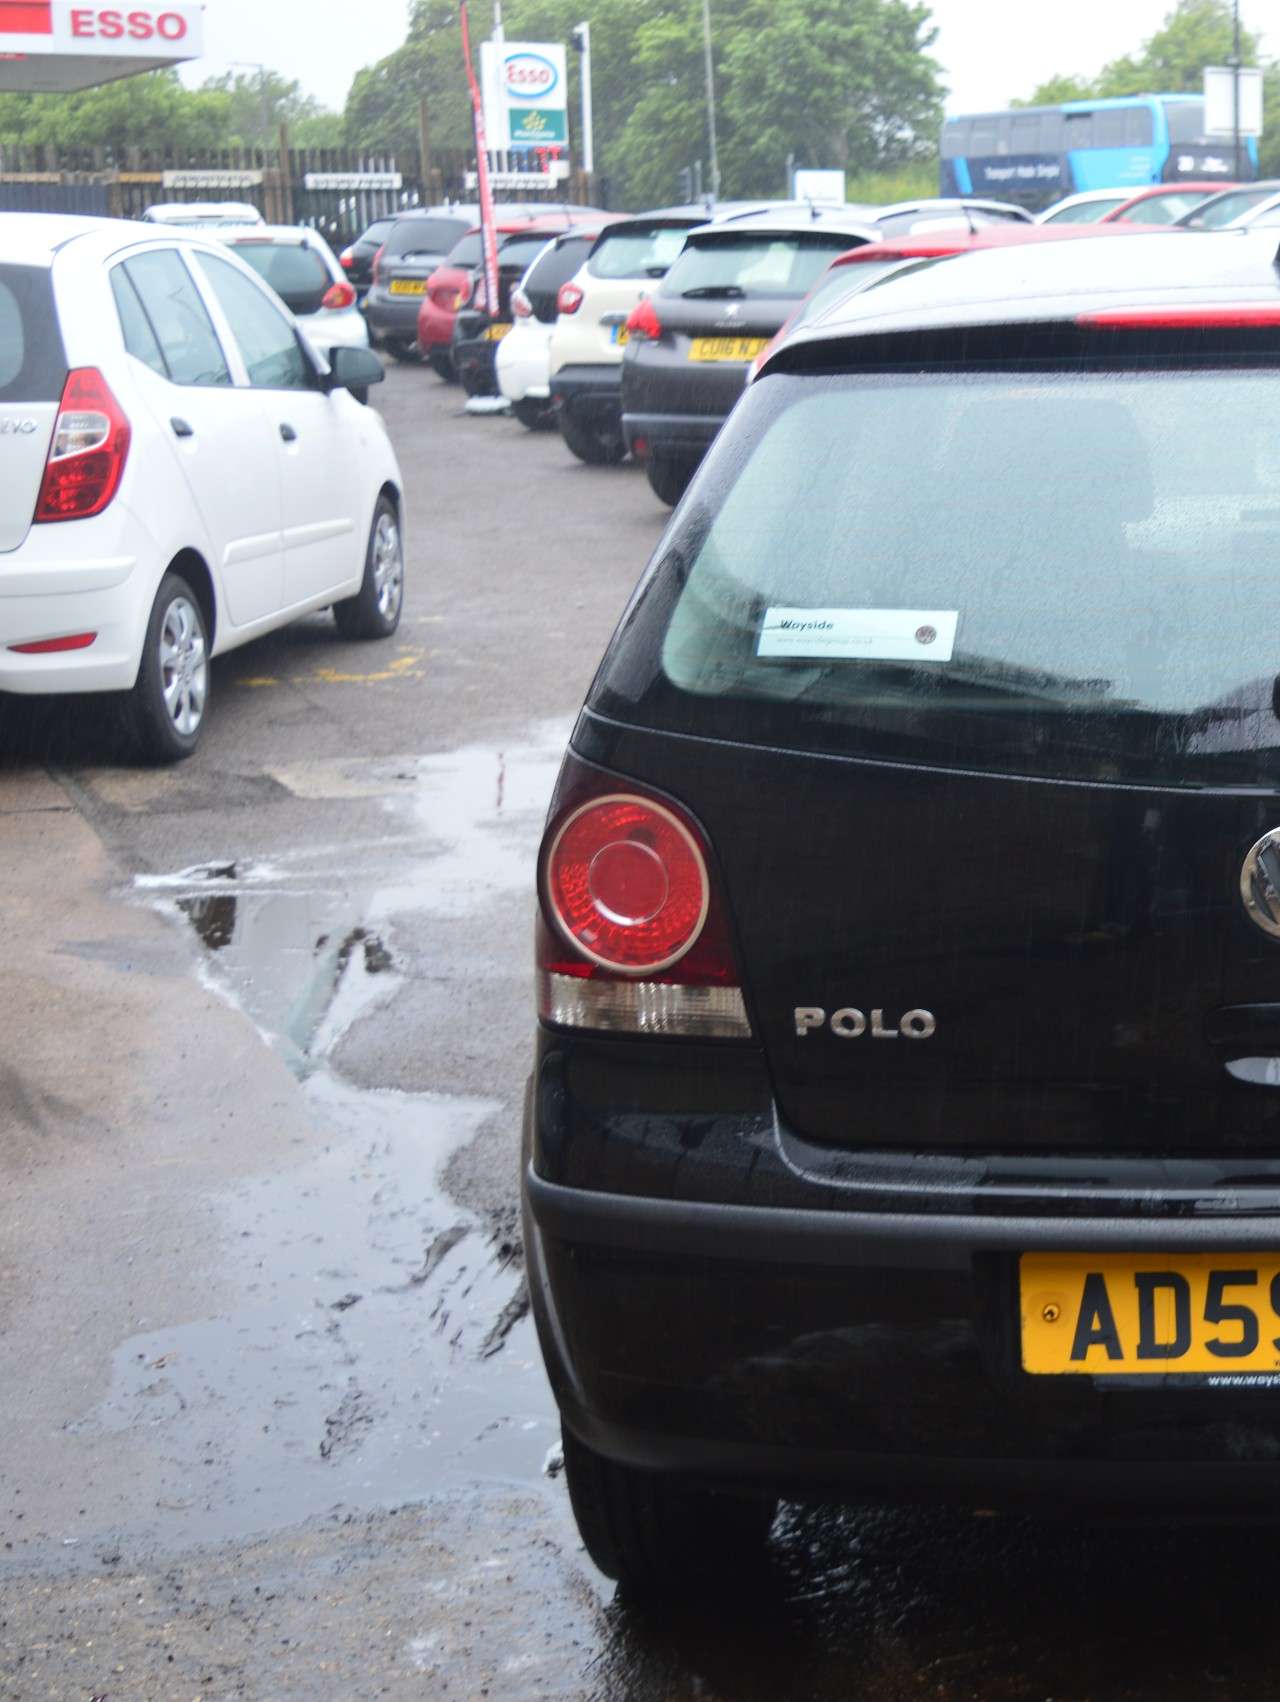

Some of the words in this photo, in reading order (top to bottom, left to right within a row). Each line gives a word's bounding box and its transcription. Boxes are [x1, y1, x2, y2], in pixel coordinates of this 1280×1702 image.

[70, 10, 188, 40] ESSO
[507, 64, 551, 84] Esso
[780, 619, 834, 631] Wayside
[794, 1007, 937, 1039] POLO
